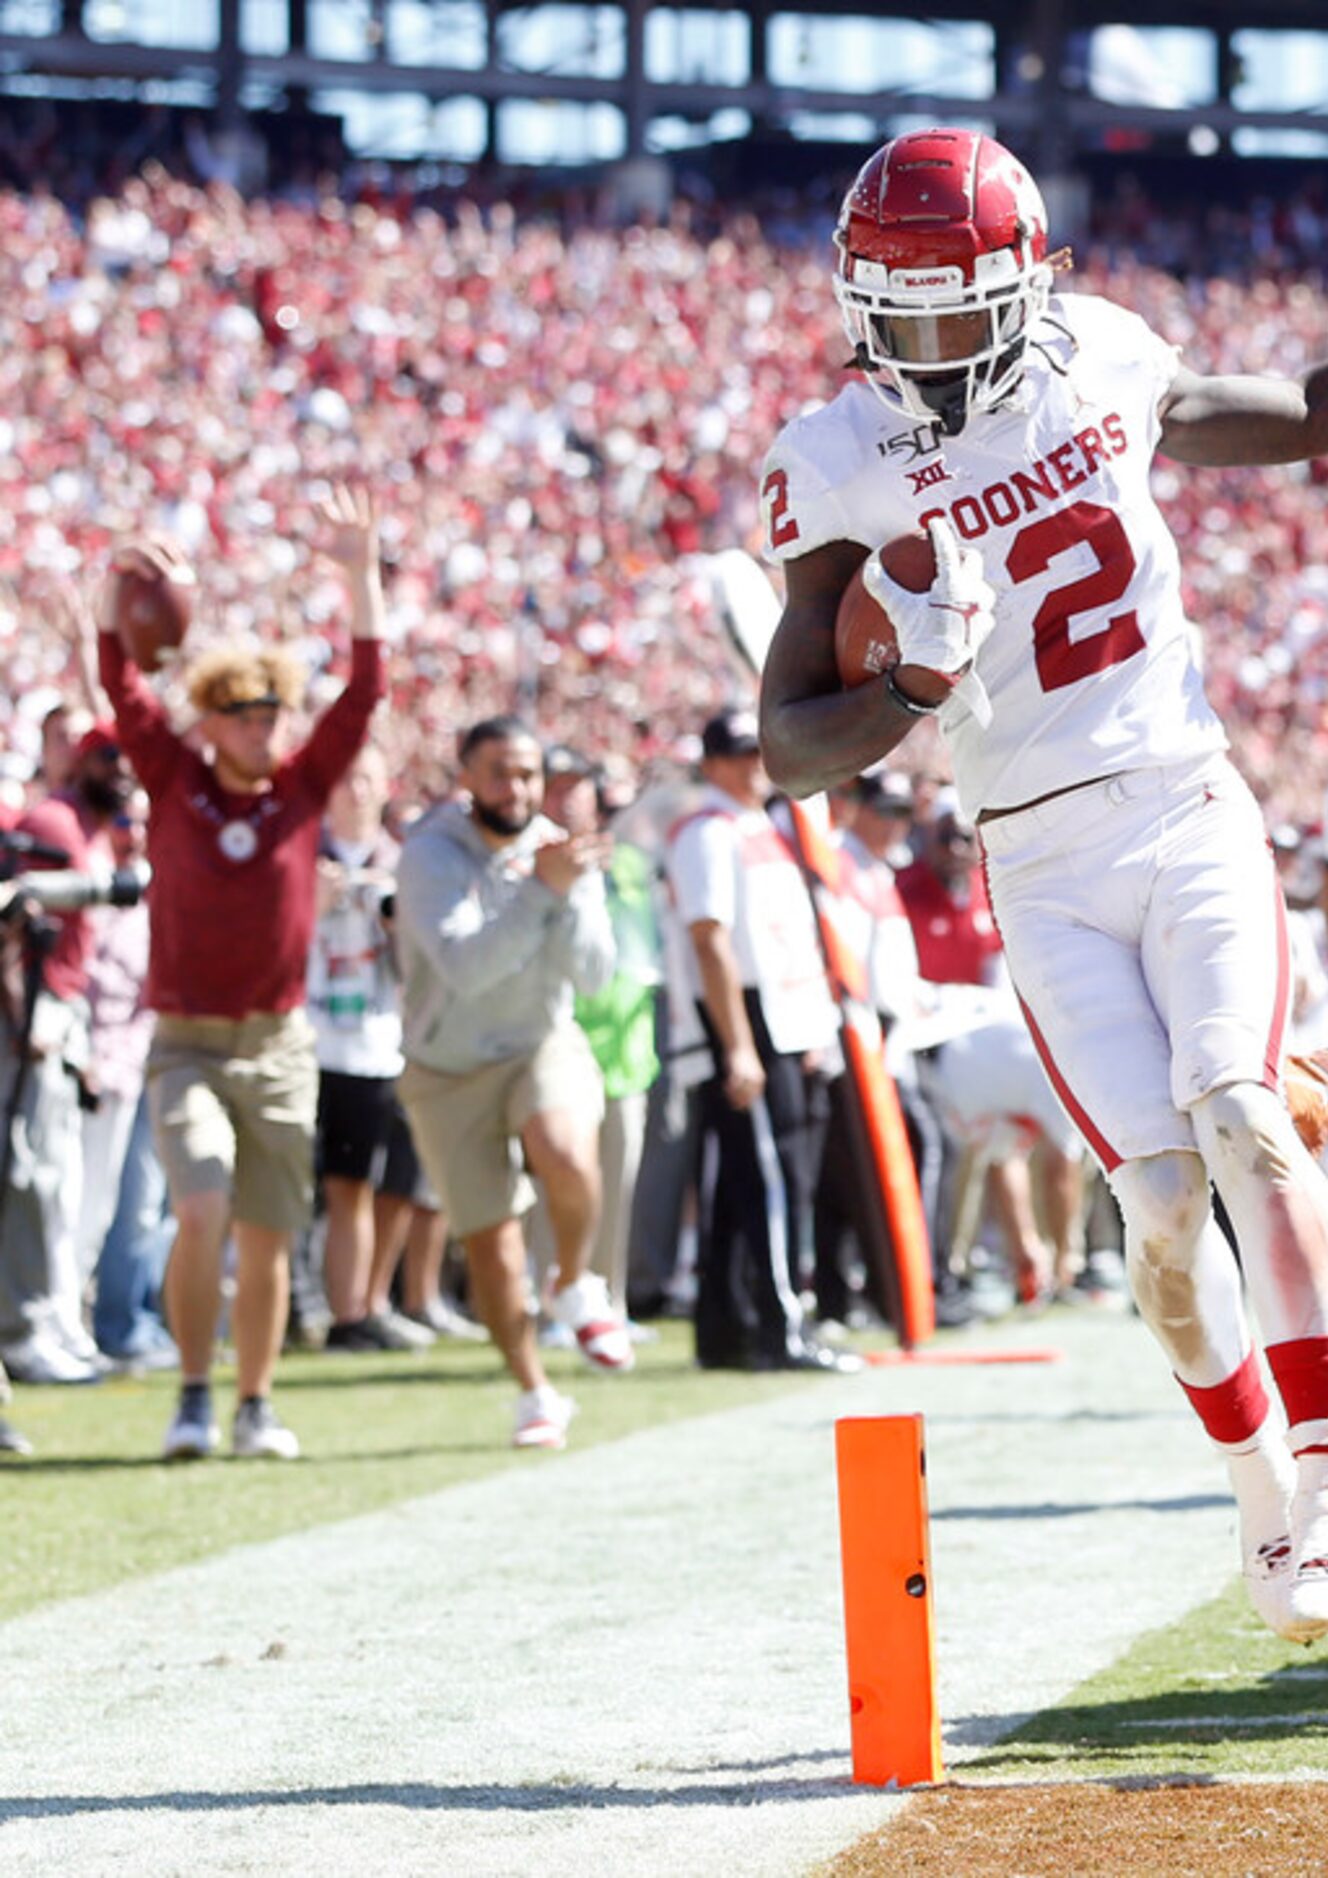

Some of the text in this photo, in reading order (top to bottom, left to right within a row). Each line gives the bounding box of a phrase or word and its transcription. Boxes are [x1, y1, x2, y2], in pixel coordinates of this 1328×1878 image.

[877, 420, 941, 464] 150
[763, 468, 800, 550] 2
[904, 459, 952, 496] XII
[1005, 500, 1147, 693] 2
